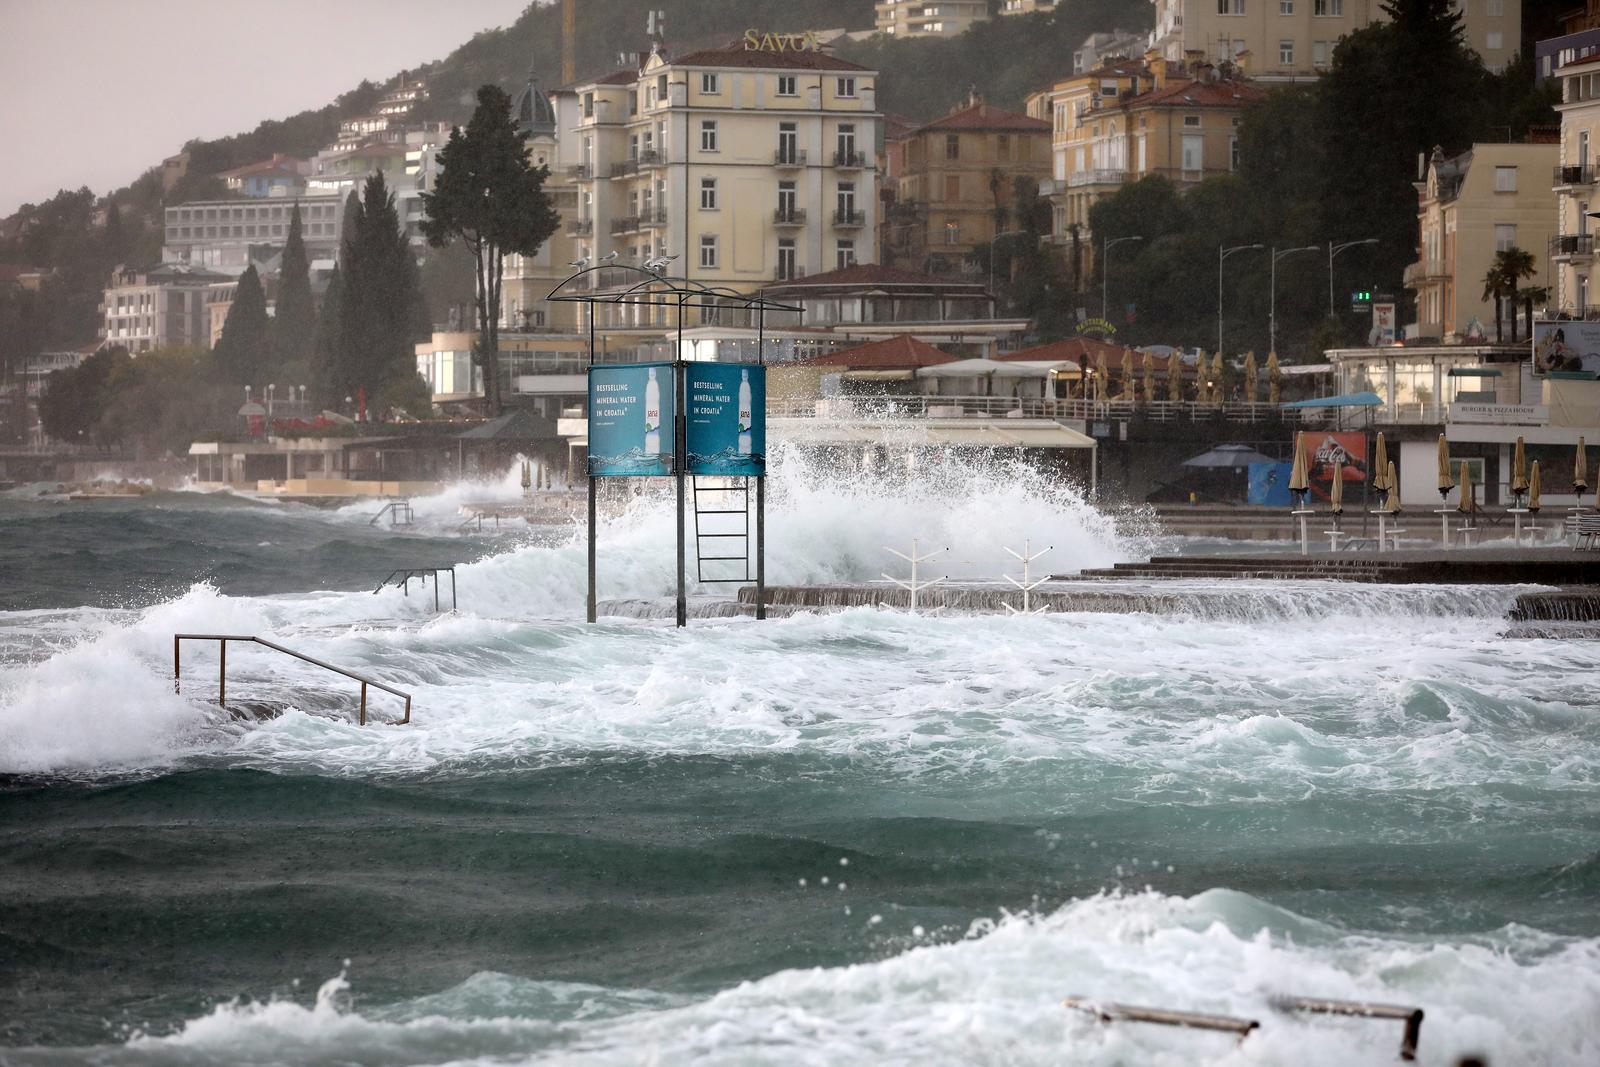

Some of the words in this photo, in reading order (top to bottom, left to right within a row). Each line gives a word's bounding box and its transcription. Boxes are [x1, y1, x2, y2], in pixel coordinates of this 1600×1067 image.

[744, 28, 818, 53] SAVOY
[693, 381, 723, 390] BESTSELLING
[693, 394, 714, 402] MINERAL
[715, 395, 731, 403] WATER
